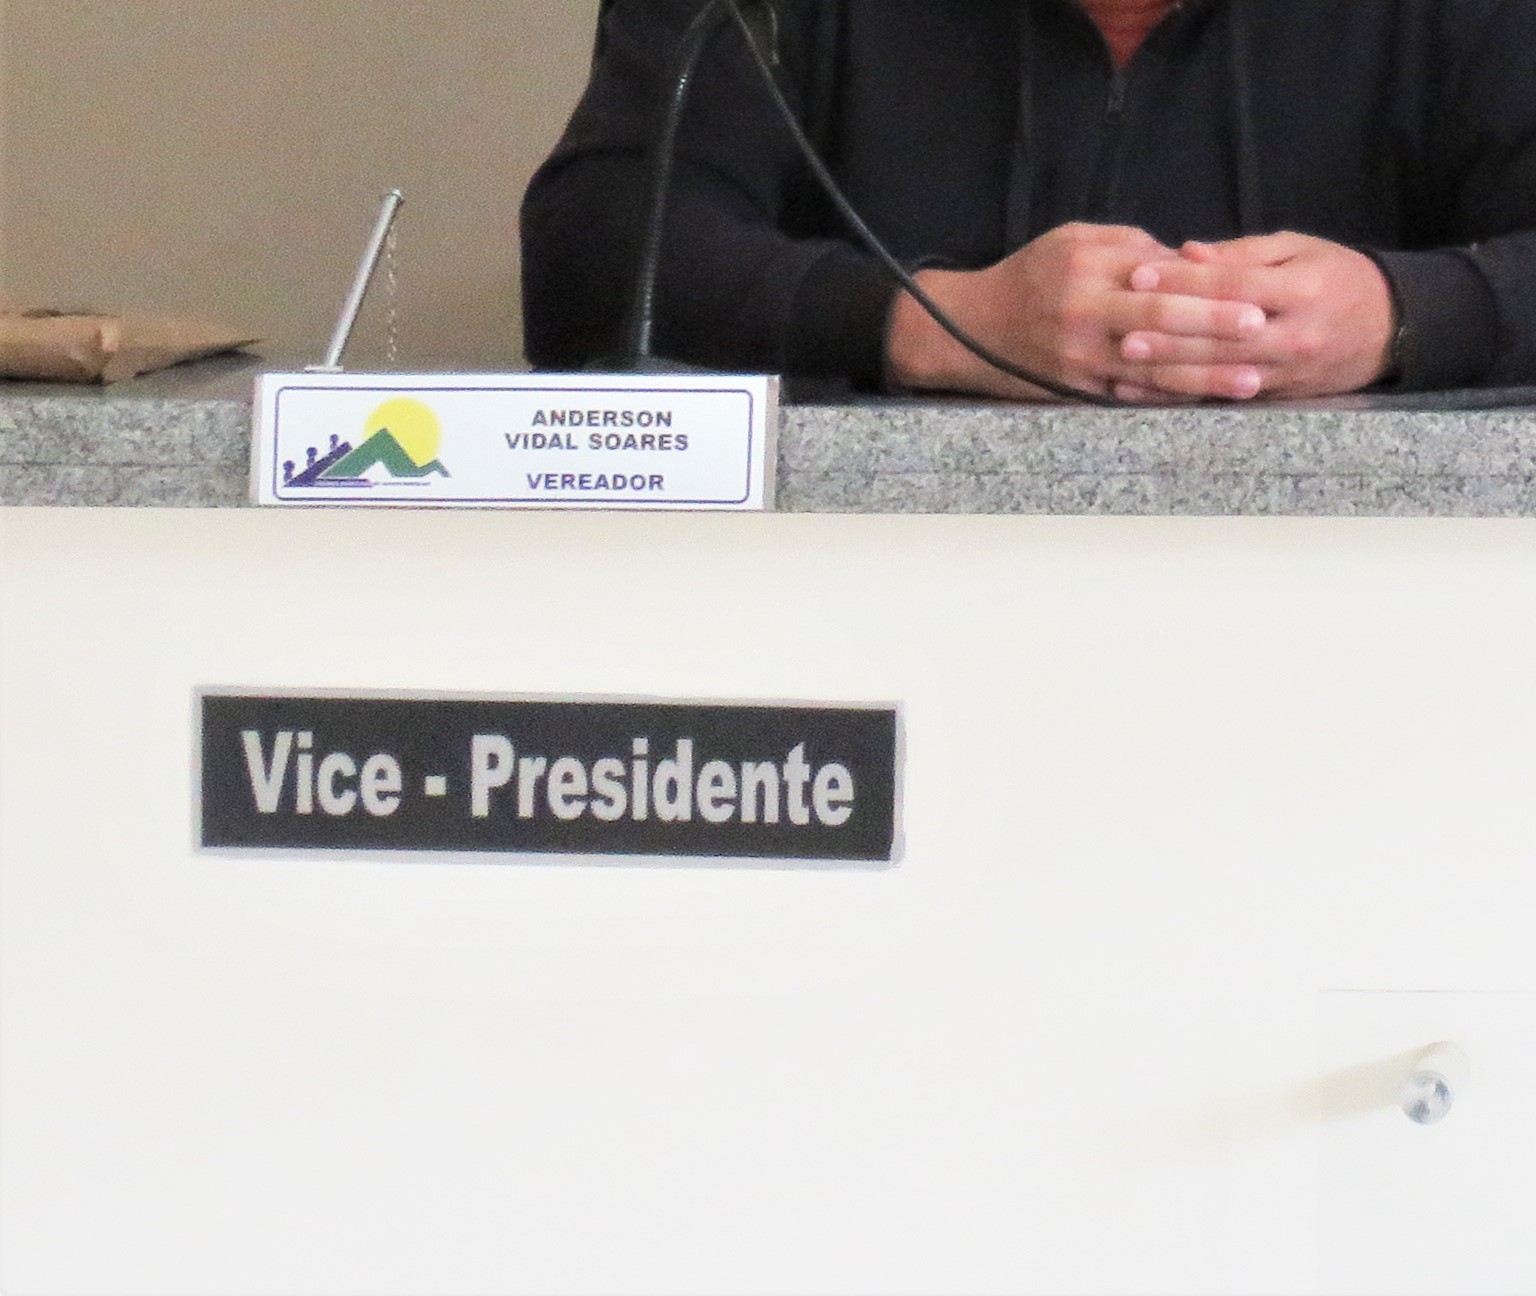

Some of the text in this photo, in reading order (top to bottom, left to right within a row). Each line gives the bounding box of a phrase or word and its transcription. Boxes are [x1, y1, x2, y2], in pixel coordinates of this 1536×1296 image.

[531, 409, 672, 428] ANDERSON
[504, 432, 689, 451] VIDAL SOARES
[526, 473, 664, 491] VEREADOR
[241, 730, 855, 826] Vice - Presidente
